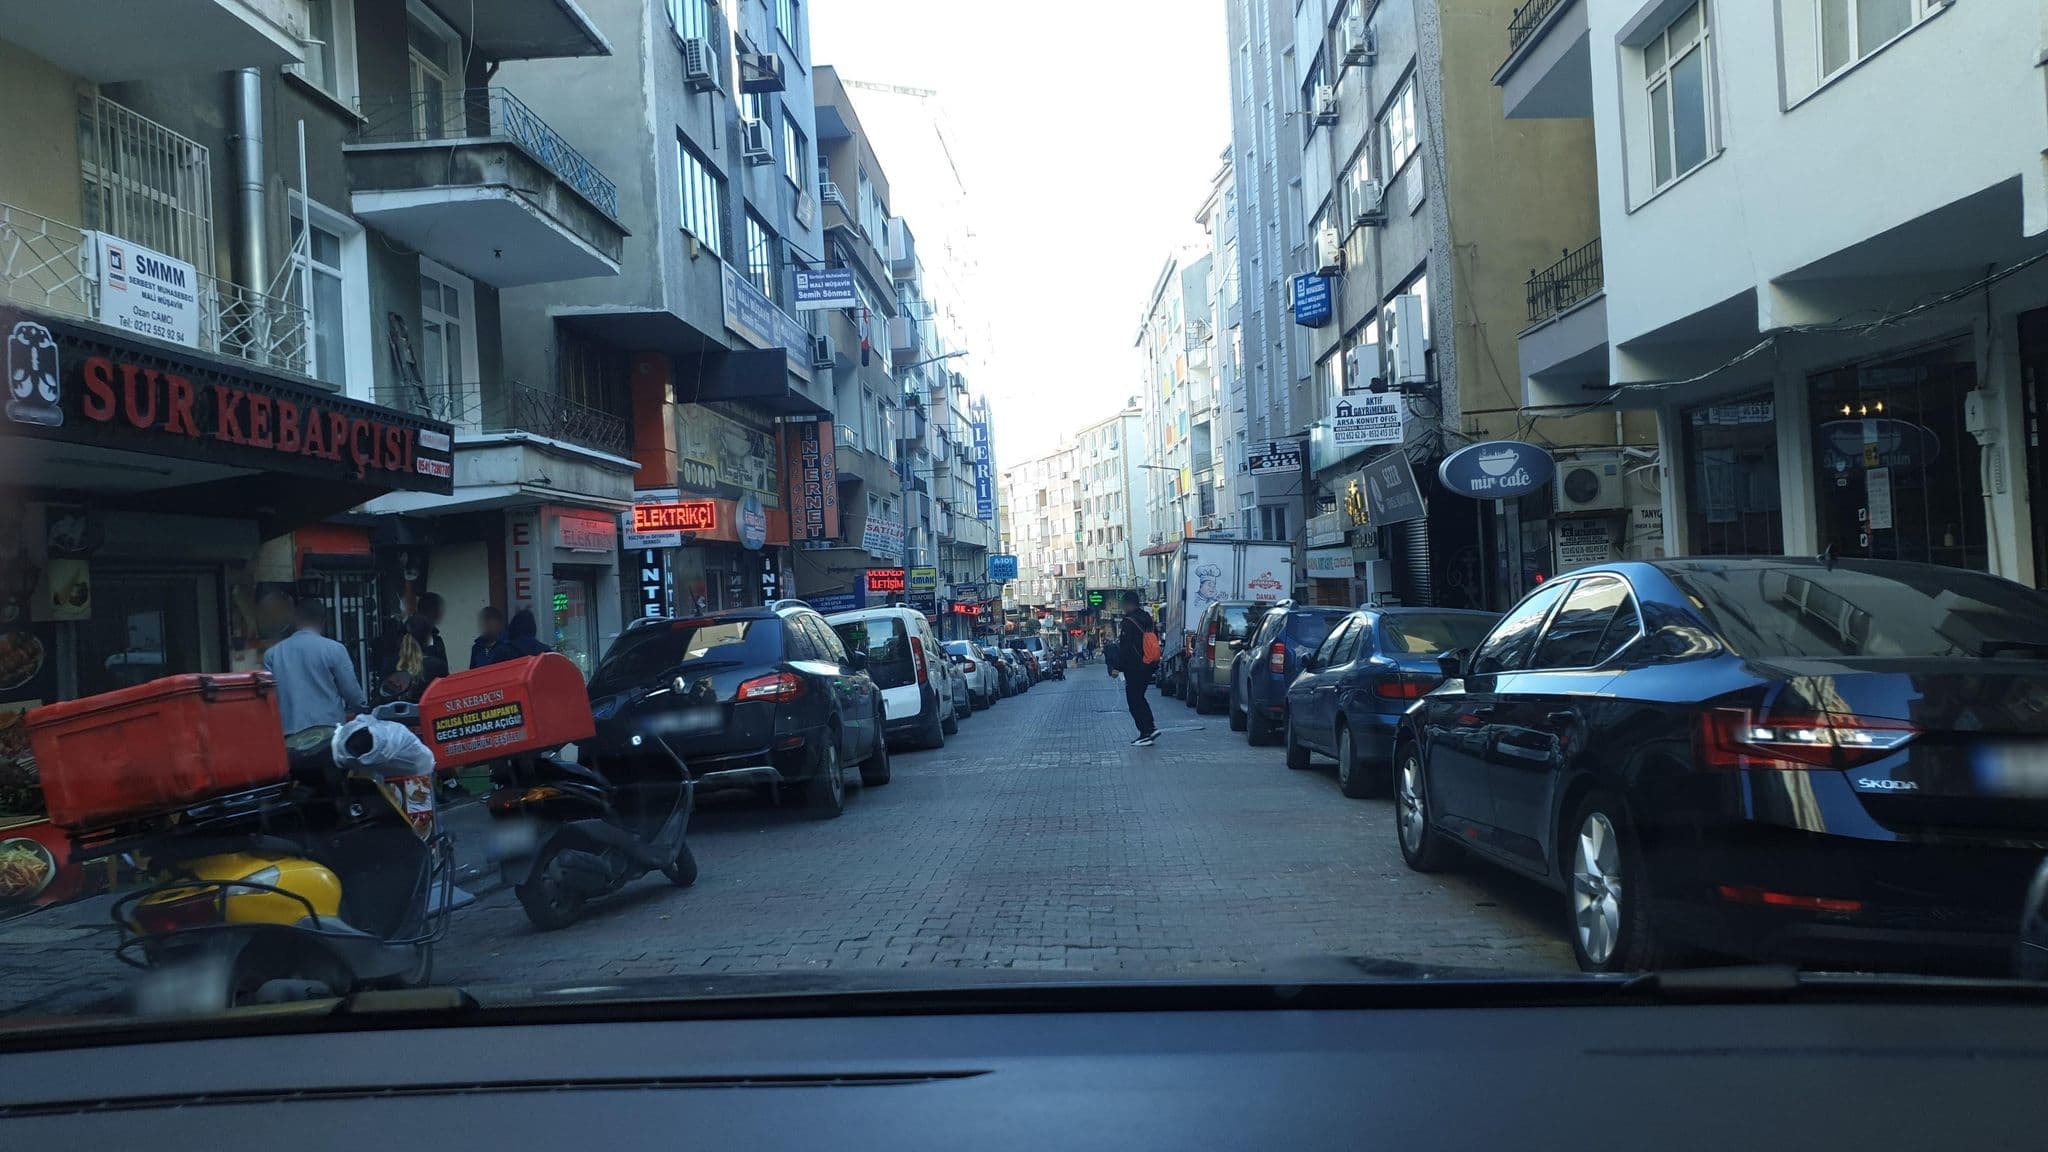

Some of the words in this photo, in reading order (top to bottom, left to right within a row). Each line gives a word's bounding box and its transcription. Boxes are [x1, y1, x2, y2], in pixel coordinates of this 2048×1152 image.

[136, 254, 186, 288] SMMM
[798, 290, 821, 299] Semih
[133, 305, 151, 318] Ozan
[134, 320, 151, 333] 0212
[153, 325, 166, 338] 552
[81, 355, 199, 438] SUR
[213, 384, 415, 479] KEBAPÇISI
[801, 424, 823, 537] INTERNET
[1471, 475, 1496, 491] mir
[634, 503, 711, 529] ELEKTRİKÇİ
[513, 523, 532, 600] ELE
[463, 711, 481, 725] ÖZEL
[481, 704, 519, 720] KAMPANYA
[436, 729, 458, 741] GECE
[465, 721, 494, 734] KADAR
